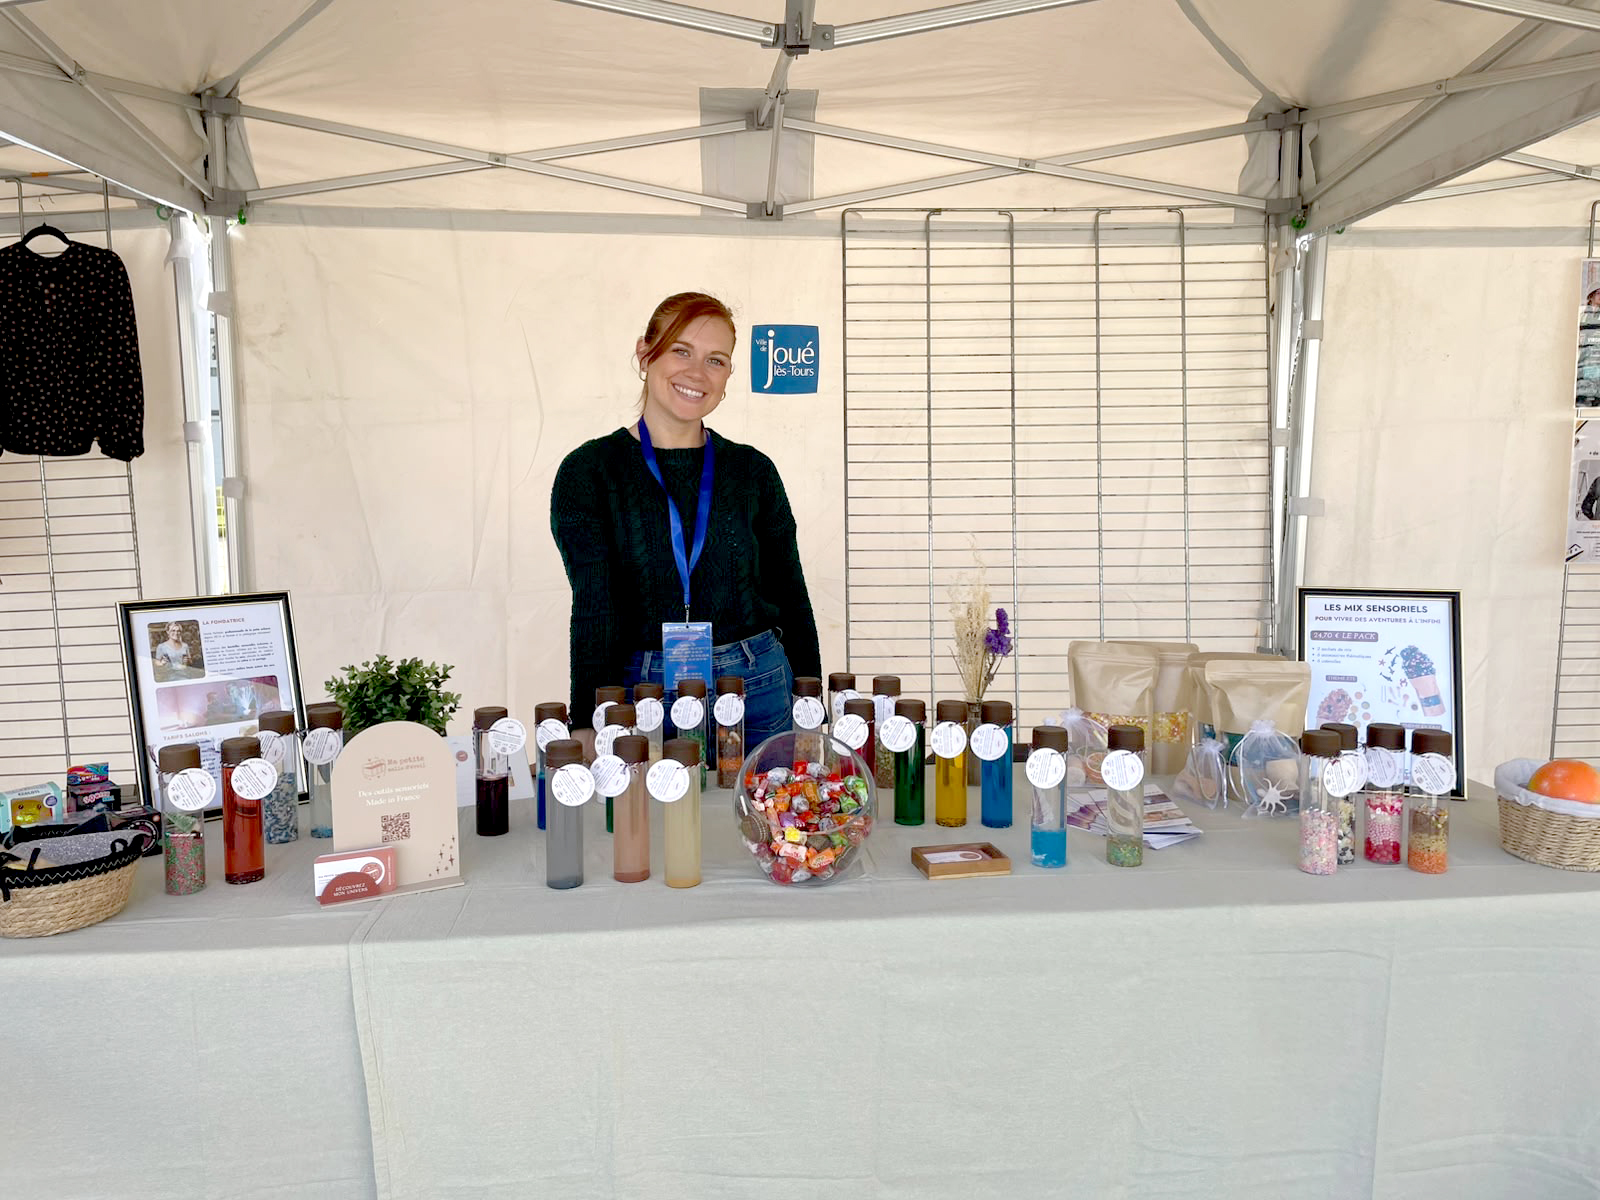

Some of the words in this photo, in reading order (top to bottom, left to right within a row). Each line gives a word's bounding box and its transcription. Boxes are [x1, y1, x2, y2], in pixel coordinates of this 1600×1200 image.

[763, 329, 815, 390] joué
[773, 365, 815, 377] lès-Tours
[1324, 603, 1342, 611] LES
[1344, 604, 1363, 612] MIX
[1366, 604, 1428, 613] SENSORIELS
[211, 617, 245, 625] FONDATRICE
[163, 733, 183, 741] TARIFS
[185, 730, 208, 738] SALONS
[358, 789, 372, 797] Des
[373, 786, 394, 795] outils
[394, 782, 429, 792] sensoriels
[366, 798, 387, 806] Made
[396, 794, 421, 802] France
[333, 889, 346, 897] MON
[346, 887, 369, 895] UNIVERS
[335, 882, 366, 892] DÉCOUVREZ
